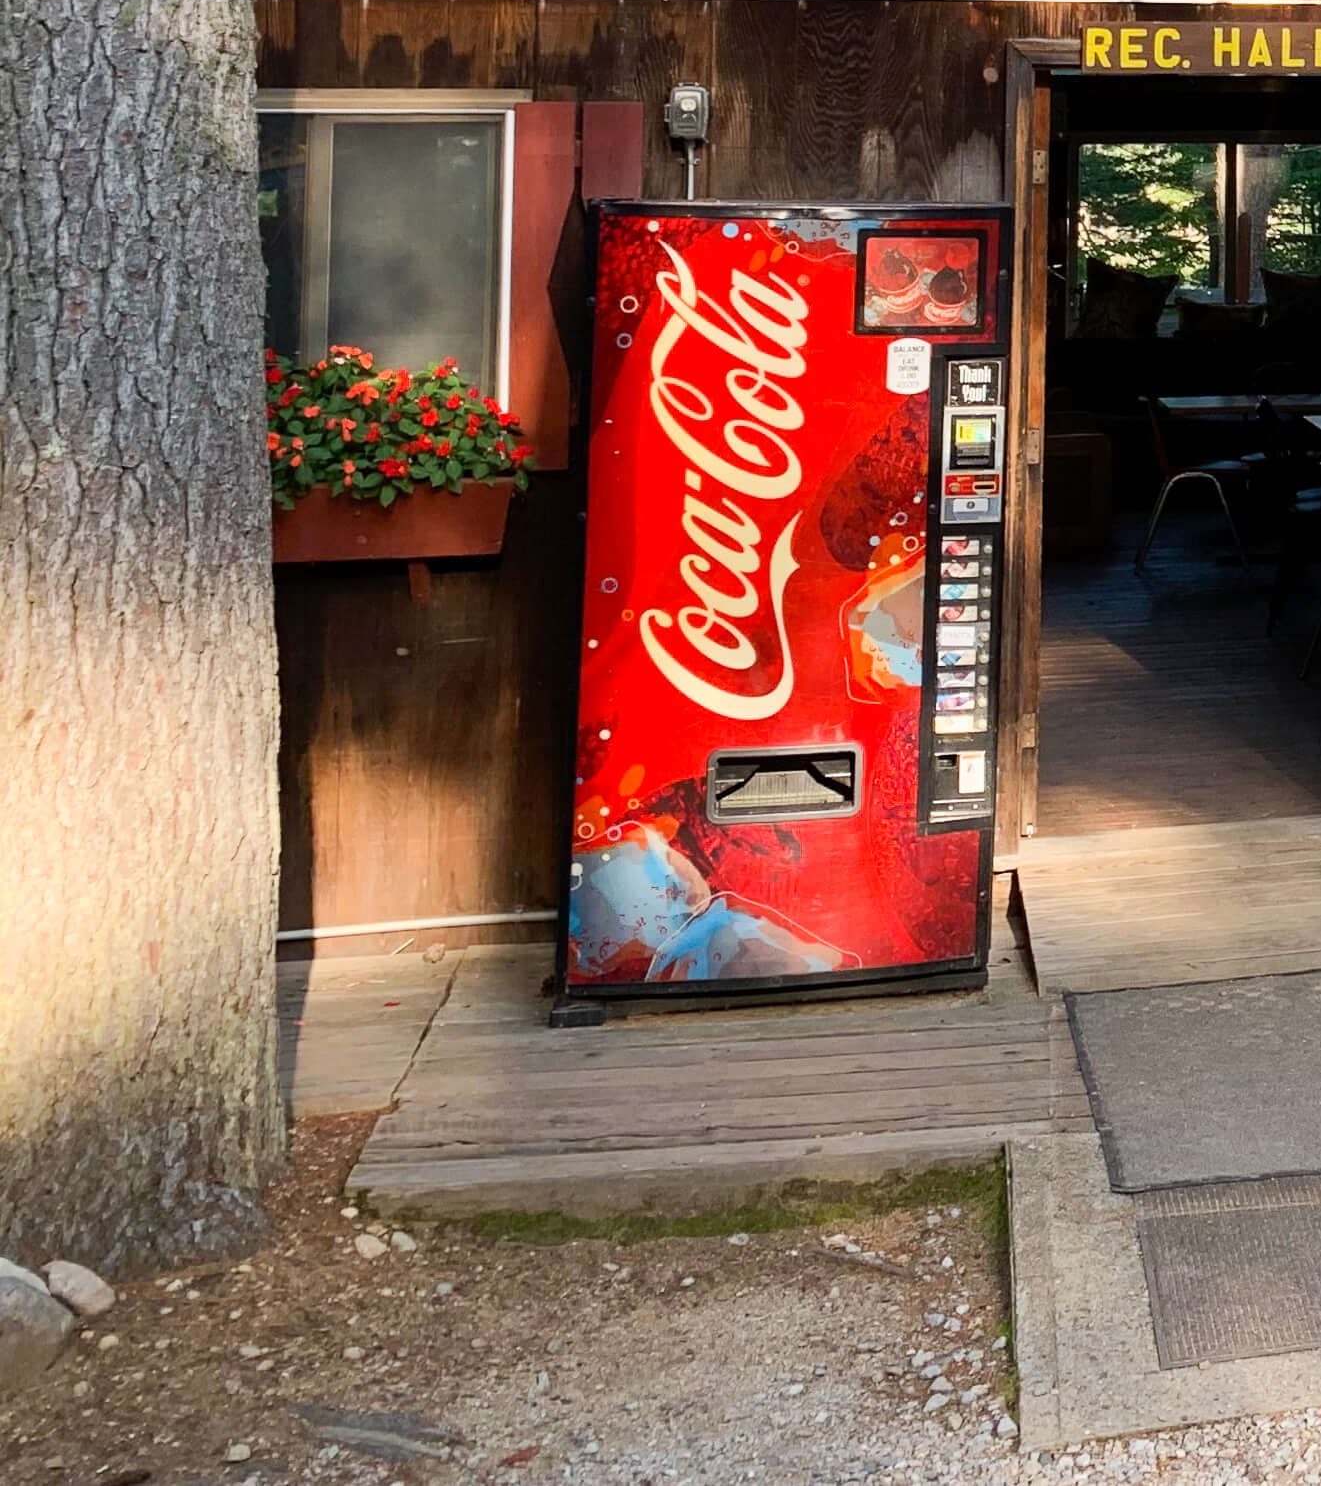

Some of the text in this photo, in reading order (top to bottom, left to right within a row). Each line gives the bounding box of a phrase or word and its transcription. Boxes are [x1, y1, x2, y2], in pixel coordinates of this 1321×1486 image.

[1086, 27, 1192, 69] REC.
[959, 365, 992, 384] Thank
[640, 239, 810, 720] Coca-Cola
